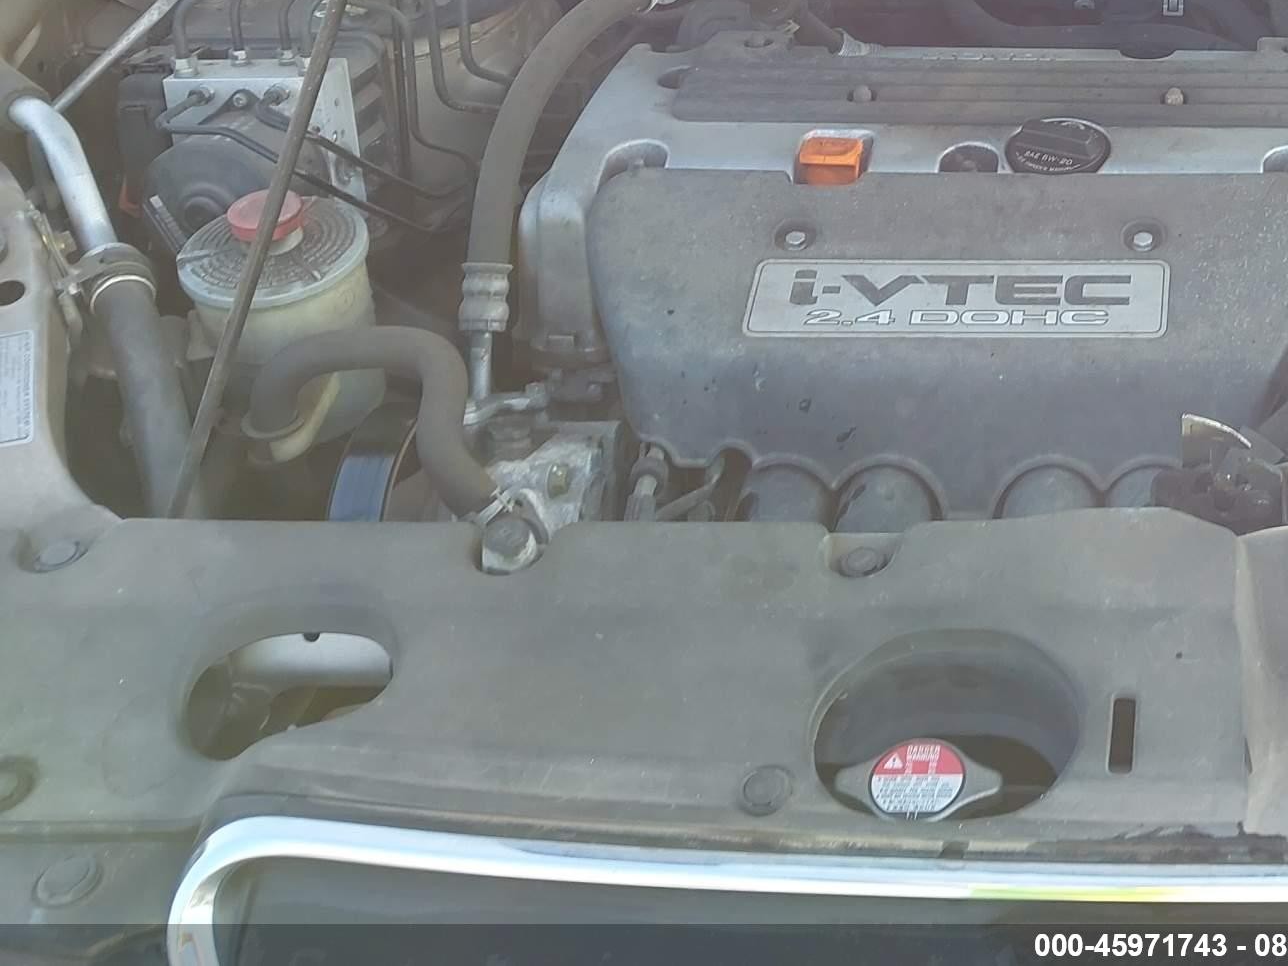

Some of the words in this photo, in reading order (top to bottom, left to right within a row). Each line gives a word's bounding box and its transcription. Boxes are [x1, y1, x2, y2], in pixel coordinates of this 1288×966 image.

[789, 269, 1132, 307] i-VTEC
[803, 309, 895, 326] 2.4
[908, 309, 1110, 326] DOHC
